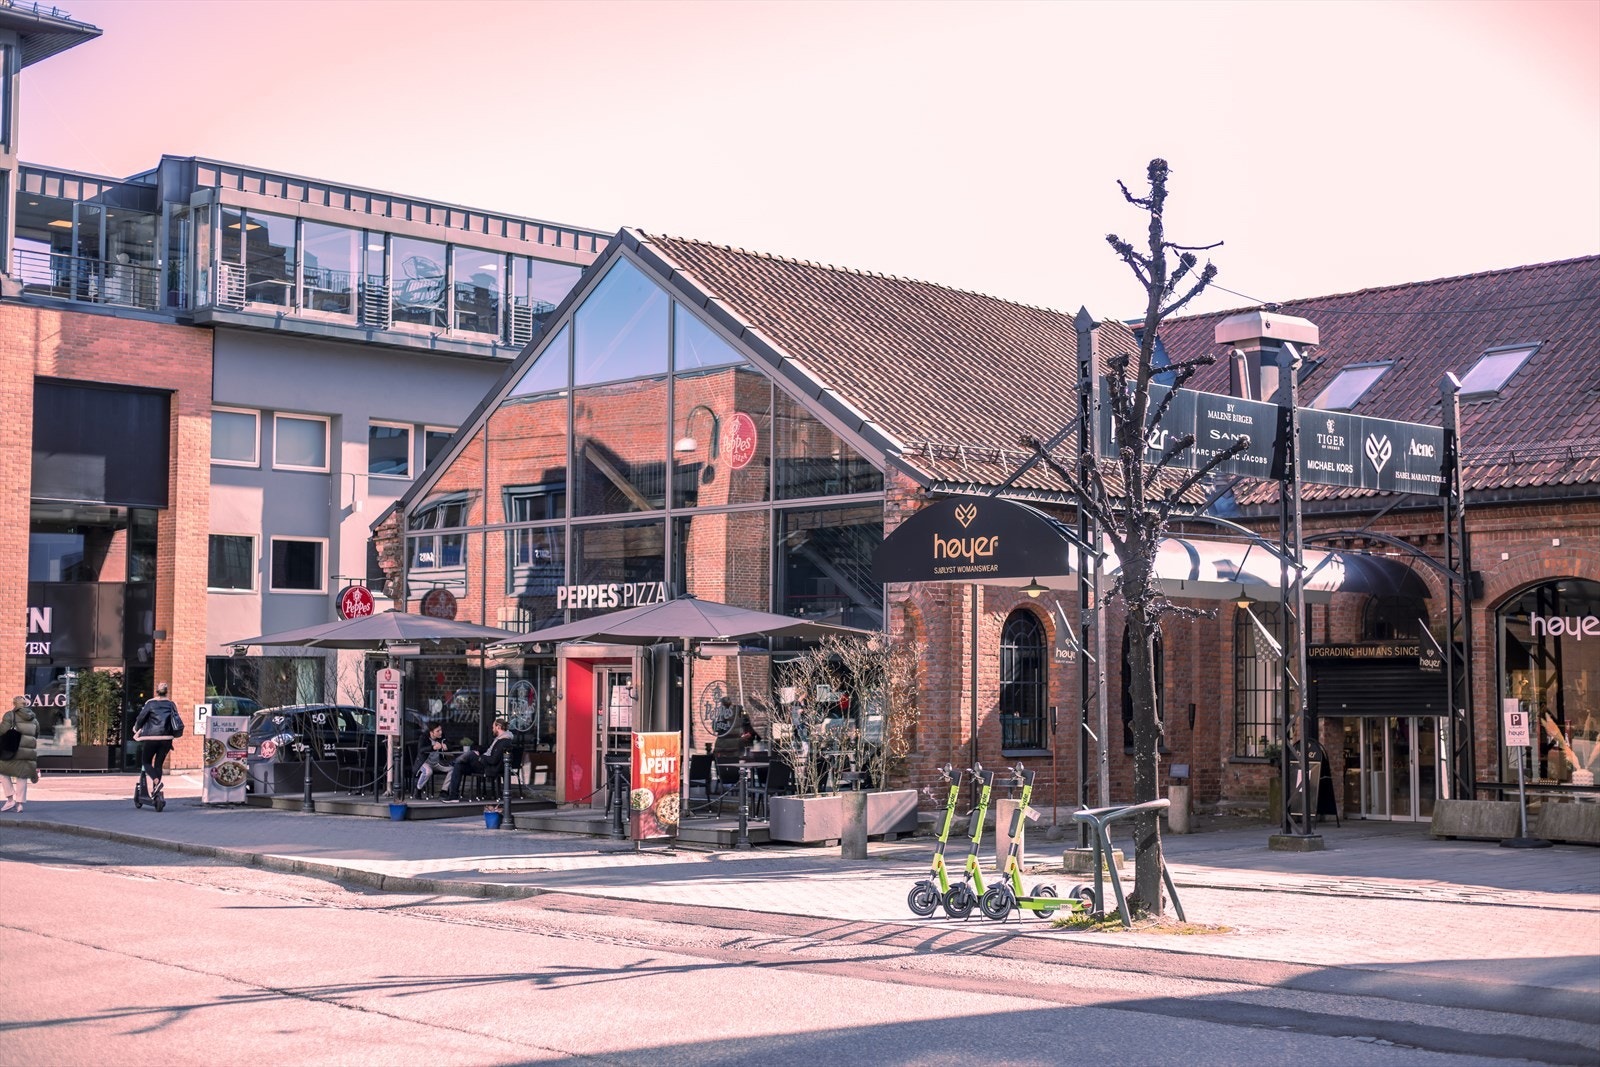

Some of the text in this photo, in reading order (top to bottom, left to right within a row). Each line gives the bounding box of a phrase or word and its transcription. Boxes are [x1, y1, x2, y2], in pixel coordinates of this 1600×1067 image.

[1226, 403, 1235, 412] BY
[1207, 410, 1253, 425] MALENE BIRGER
[723, 433, 752, 454] Peppes
[1316, 433, 1345, 447] TIGER
[1190, 447, 1210, 456] MARC
[1241, 453, 1268, 464] JACOBS
[1408, 438, 1434, 458] Acne
[1307, 459, 1354, 474] MICHAEL KORS
[1395, 470, 1411, 480] ISABEL
[1410, 472, 1431, 482] MARANT
[933, 533, 999, 564] høyer
[933, 564, 999, 575] SJØLYST WOMANSWEAR
[556, 581, 667, 609] PEPPES PIZZA
[345, 599, 371, 617] Peppes
[26, 606, 52, 634] N
[1308, 646, 1420, 657] UPGRADING HUMANS SINCE
[1419, 657, 1441, 669] høyer
[198, 706, 208, 721] P
[1512, 714, 1520, 726] P
[640, 752, 677, 775] ÅPENT
